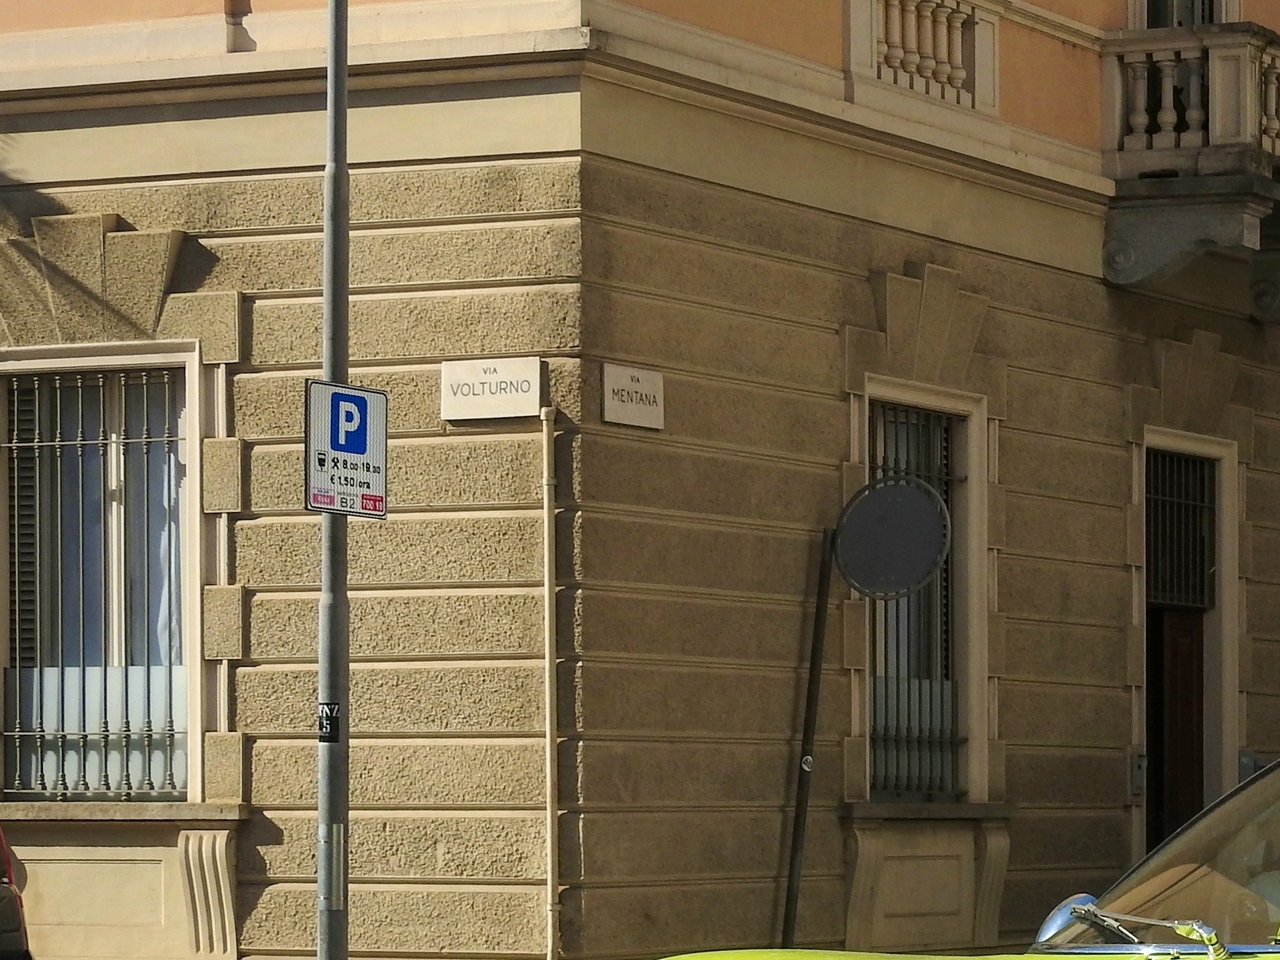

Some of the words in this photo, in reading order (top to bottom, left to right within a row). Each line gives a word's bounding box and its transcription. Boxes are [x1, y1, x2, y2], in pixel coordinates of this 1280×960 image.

[483, 367, 498, 375] VIA
[630, 375, 641, 383] VIA
[450, 379, 531, 397] VOLTURNO
[612, 388, 659, 408] MENTANA
[338, 400, 361, 445] P
[341, 497, 355, 509] B2
